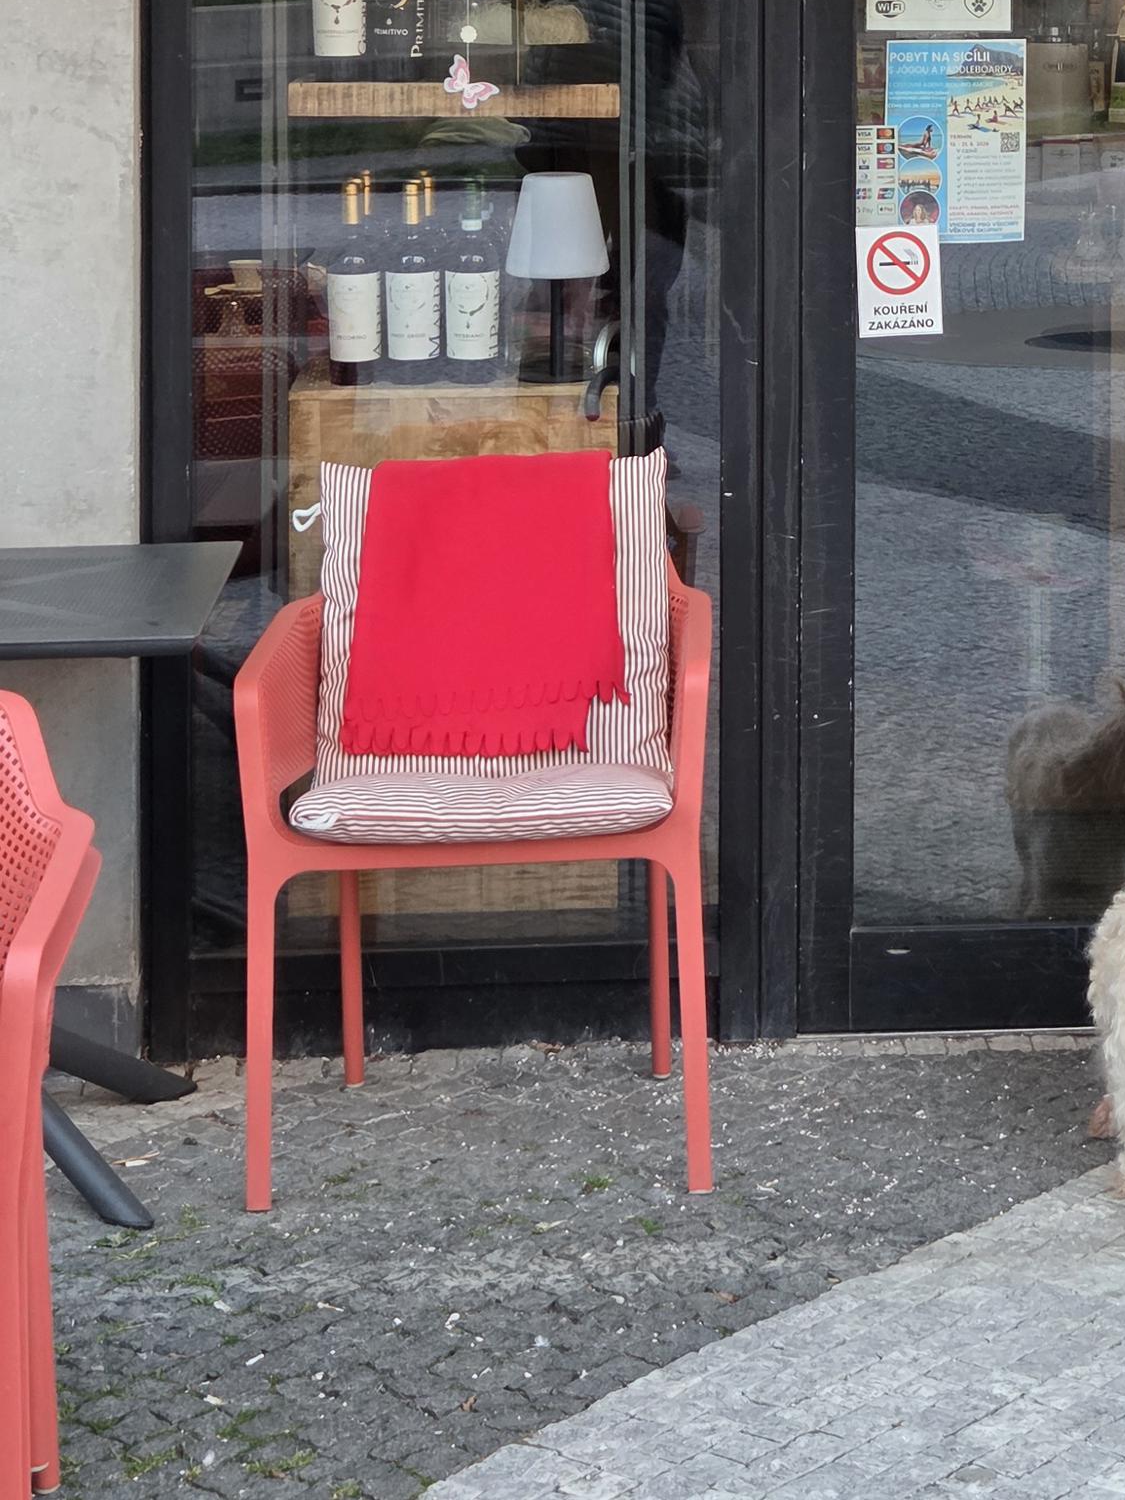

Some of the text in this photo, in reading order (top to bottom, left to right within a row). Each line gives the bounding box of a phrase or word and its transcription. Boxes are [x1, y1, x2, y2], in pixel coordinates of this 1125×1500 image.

[890, 51, 929, 62] POBYT
[932, 51, 950, 62] NA
[931, 65, 938, 74] A
[873, 303, 928, 316] KOUŘENÍ
[868, 318, 935, 331] ZAKÁZÁNO
